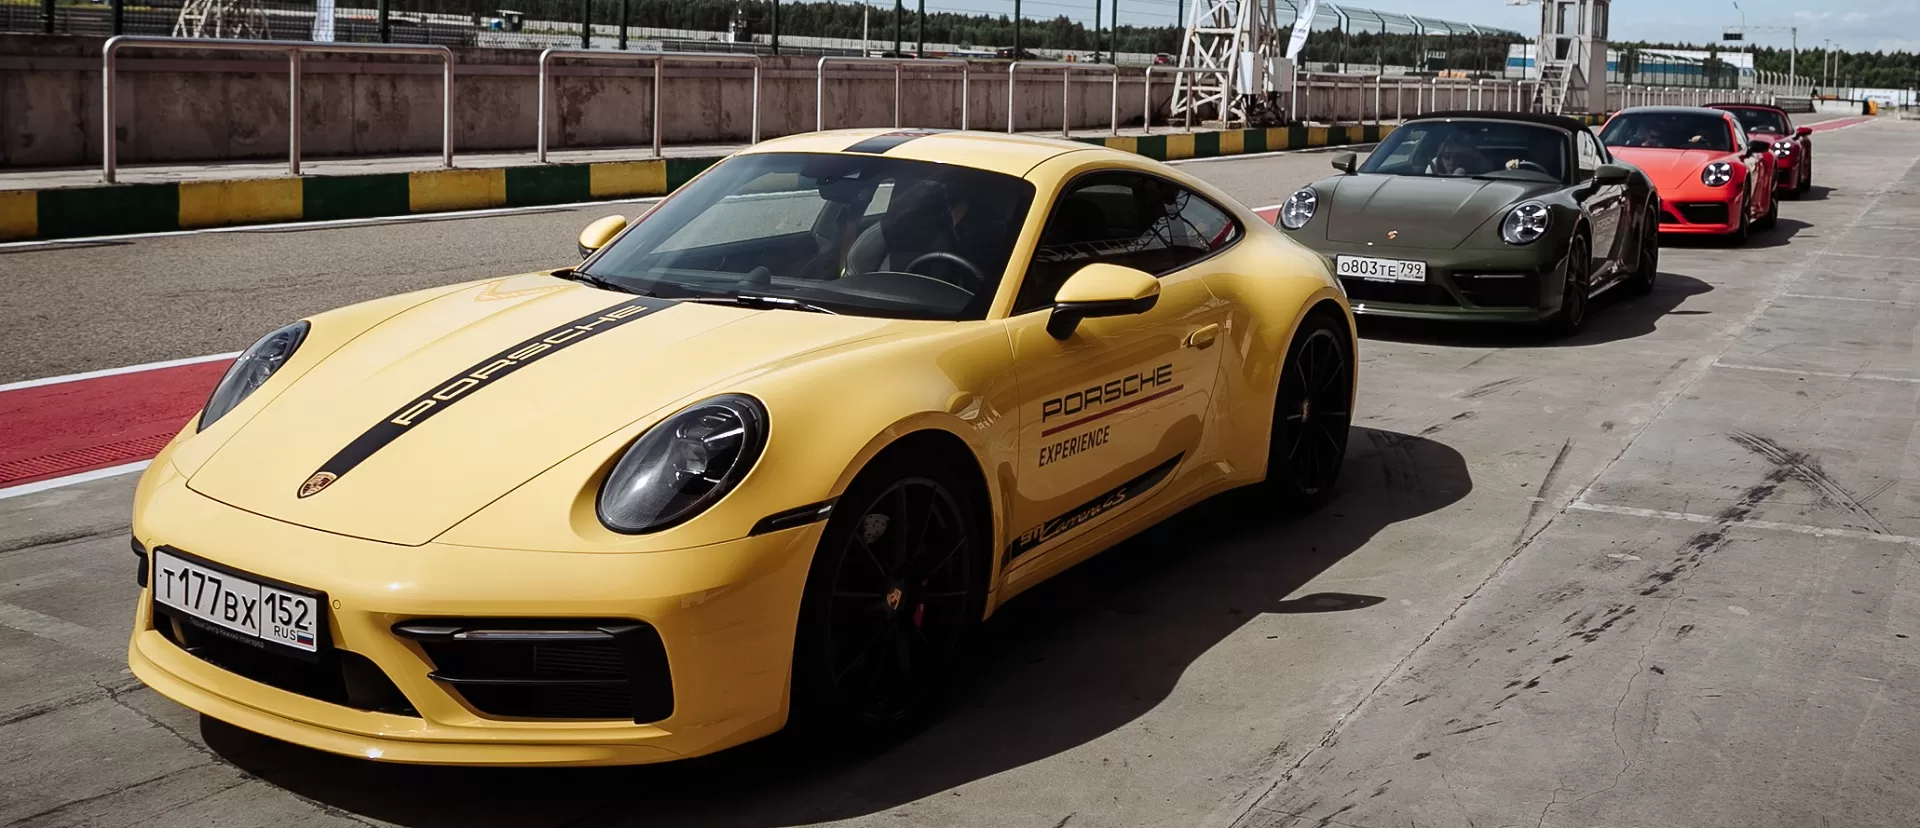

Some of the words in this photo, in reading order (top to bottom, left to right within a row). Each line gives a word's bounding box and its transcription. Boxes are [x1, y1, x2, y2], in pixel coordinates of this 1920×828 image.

[1400, 262, 1422, 275] 799
[391, 304, 648, 426] PORSCHE
[1042, 363, 1172, 423] PORSCHE
[1038, 425, 1110, 468] EXPERIENCE
[1020, 521, 1044, 546] 911
[1039, 505, 1101, 542] Carrera
[1103, 488, 1127, 508] 4S
[264, 592, 309, 632] 152
[274, 626, 296, 641] RUS
